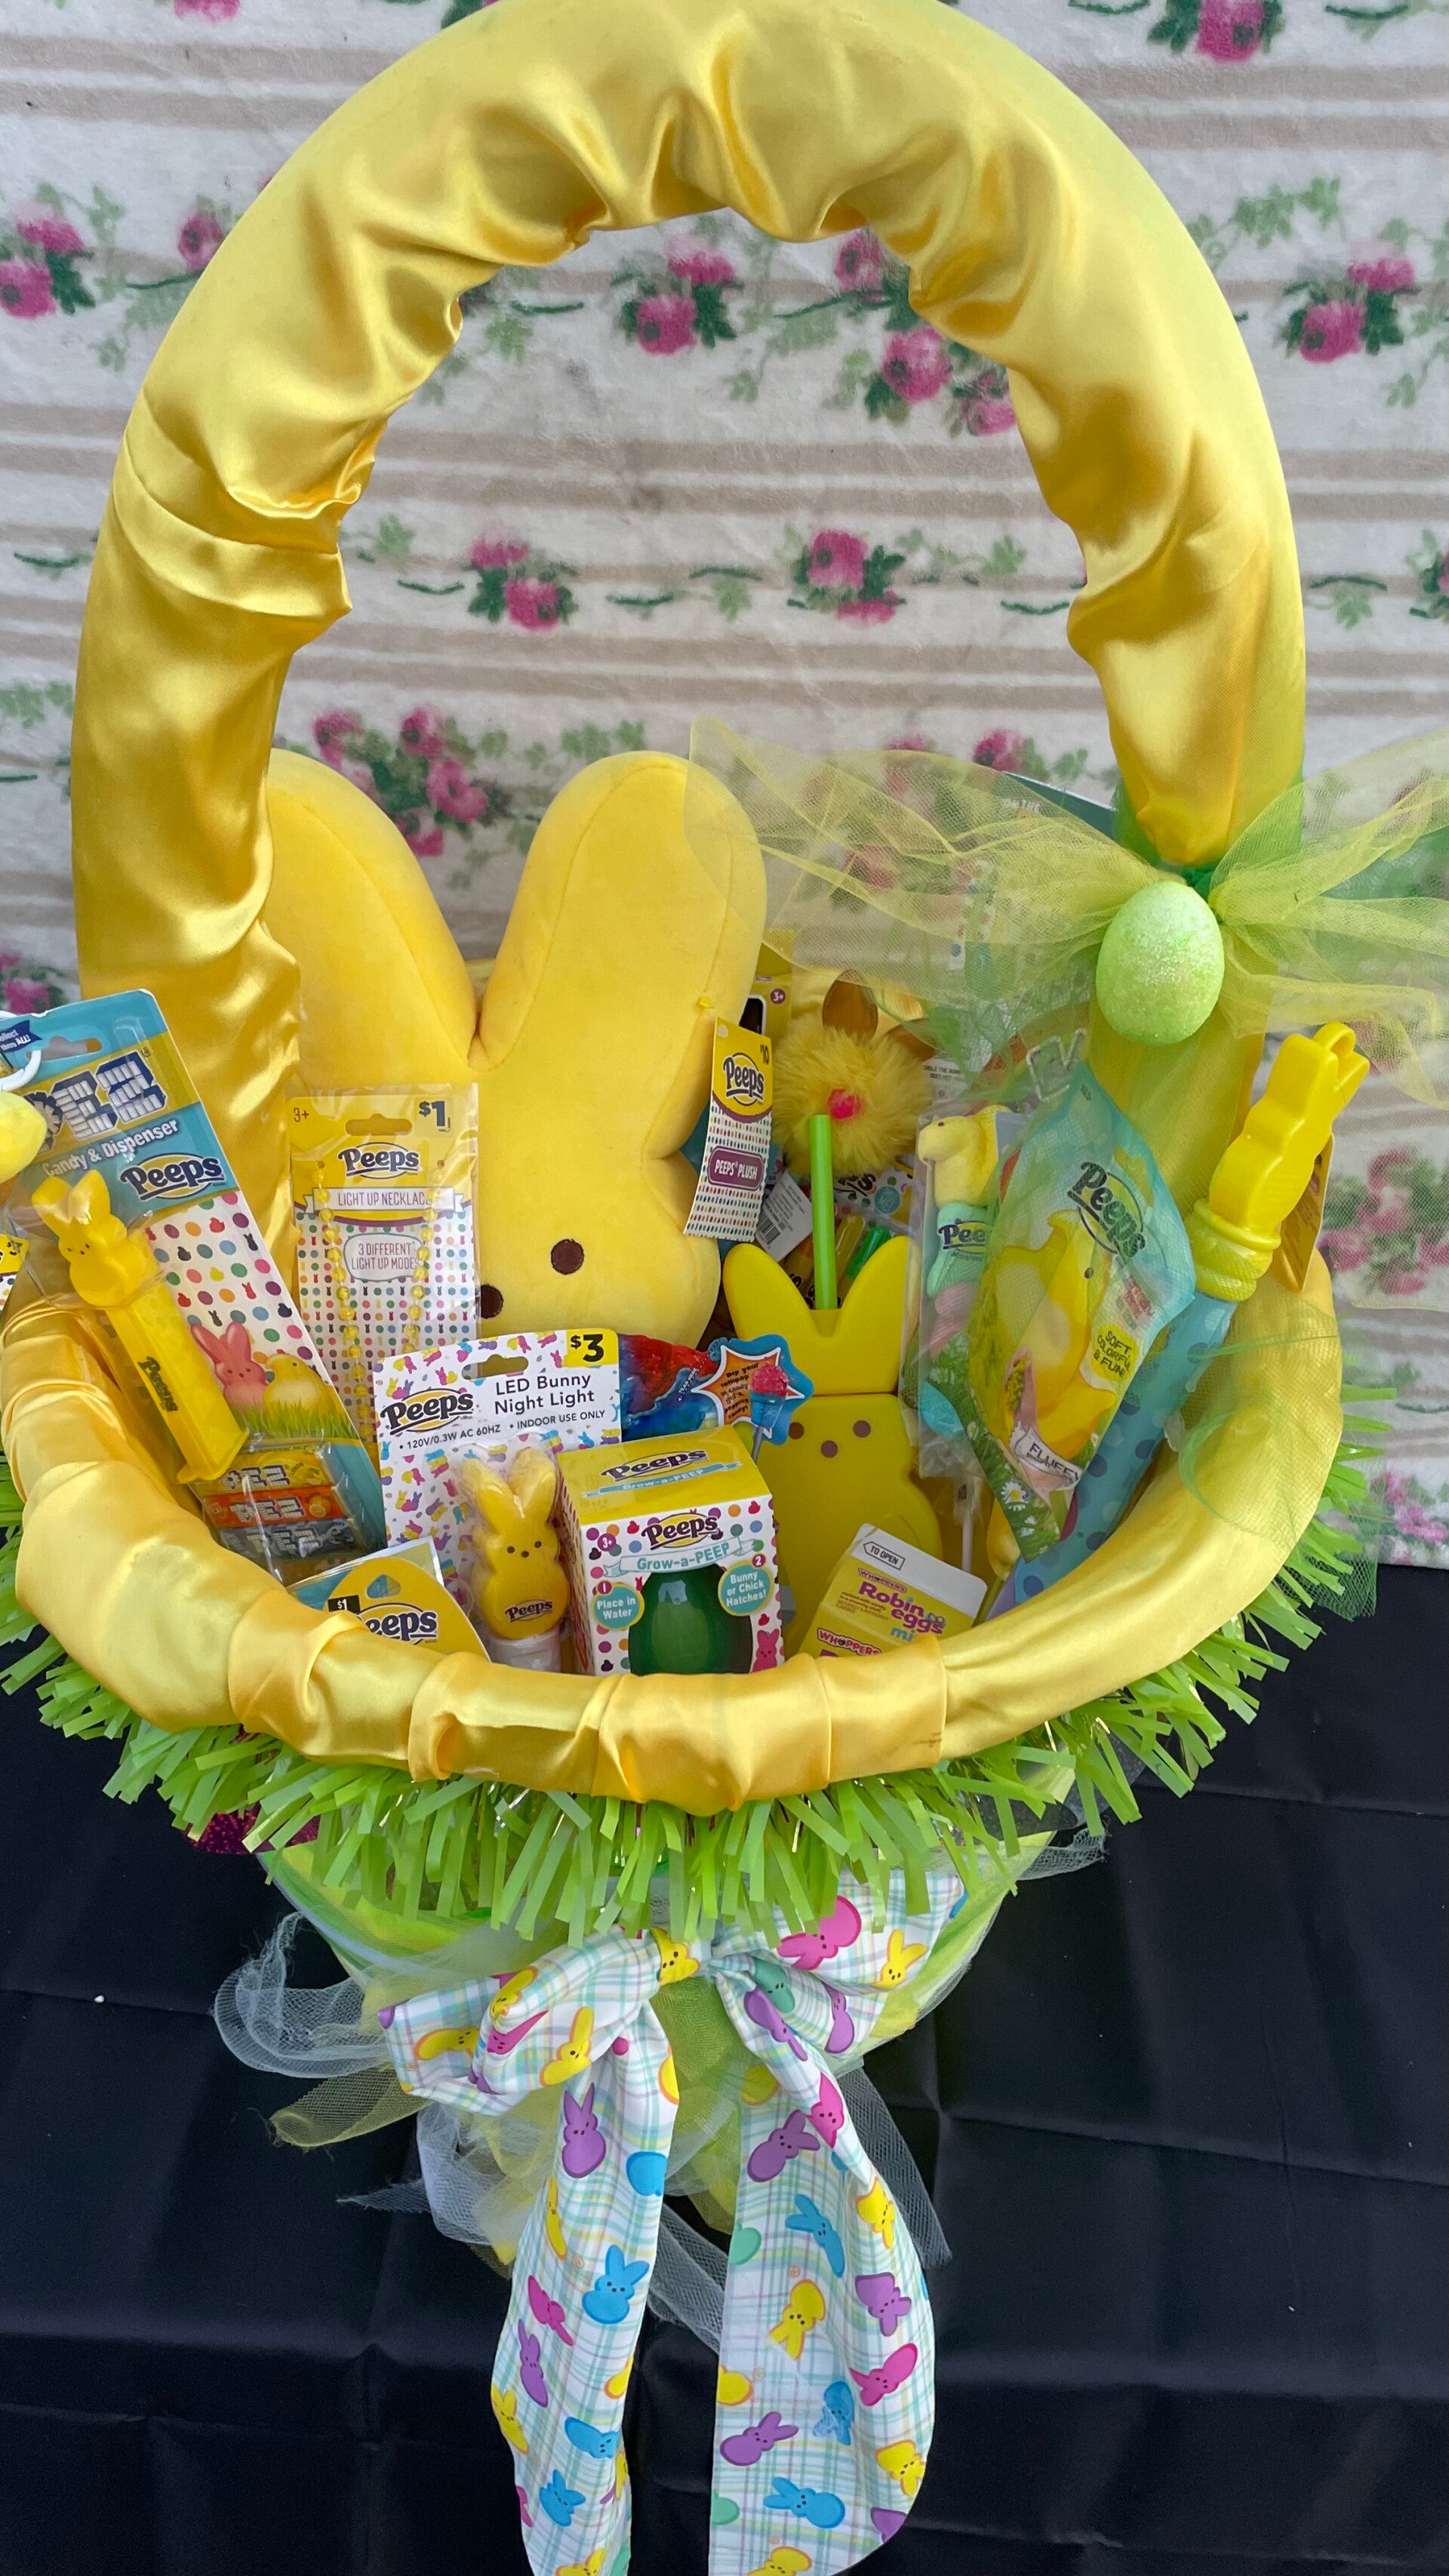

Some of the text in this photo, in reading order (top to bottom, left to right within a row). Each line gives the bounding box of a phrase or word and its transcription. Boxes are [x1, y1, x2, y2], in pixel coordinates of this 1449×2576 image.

[723, 1057, 764, 1099] Peeps
[294, 1107, 309, 1122] 3+
[419, 1100, 446, 1127] $1
[42, 1119, 180, 1177] Candy & Dispenser
[338, 1148, 420, 1175] Peeps
[737, 1163, 758, 1180] PLUSH
[120, 1158, 224, 1200] Peeps
[338, 1193, 364, 1206] LIGHT
[367, 1193, 380, 1205] UP
[1081, 1161, 1146, 1257] Peeps
[938, 1224, 986, 1247] Pee
[358, 1243, 412, 1256] 3 DIFFERENT
[352, 1257, 420, 1270] LIGHT UP MODES
[570, 1333, 605, 1363] $3
[1106, 1331, 1132, 1354] SOFT
[742, 1363, 758, 1374] your
[137, 1356, 178, 1411] Peeps
[496, 1374, 592, 1396] LED Bunny
[721, 1374, 749, 1387] lollipop
[380, 1393, 474, 1435] Peeps
[494, 1390, 595, 1416] Night Light
[517, 1409, 606, 1430] INDOOR USE ONLY
[407, 1423, 501, 1450] 120V/0.3W AC 60HZ
[220, 1464, 291, 1491] PEZ
[601, 1450, 707, 1482] Peeps
[622, 1469, 704, 1490] Grow-a-PEEP
[229, 1496, 306, 1522] PEZ
[602, 1537, 613, 1547] 3+
[641, 1516, 718, 1550] Peeps
[637, 1542, 730, 1571] Grow-a-PEEP
[755, 1555, 762, 1566] 2
[870, 1545, 899, 1565] TO OPEN
[727, 1579, 764, 1596] or Chick
[730, 1571, 759, 1586] Bunny
[860, 1568, 907, 1593] WHOPPERS
[337, 1599, 348, 1611] $1
[596, 1596, 636, 1610] Place in
[726, 1590, 767, 1608] Hatches!
[858, 1581, 925, 1617] Robin
[505, 1601, 552, 1622] Peeps
[603, 1608, 632, 1620] Water
[891, 1606, 945, 1635] eggs
[365, 1611, 438, 1641] eeps
[890, 1627, 915, 1642] mi
[818, 1630, 881, 1656] WHOPPERS
